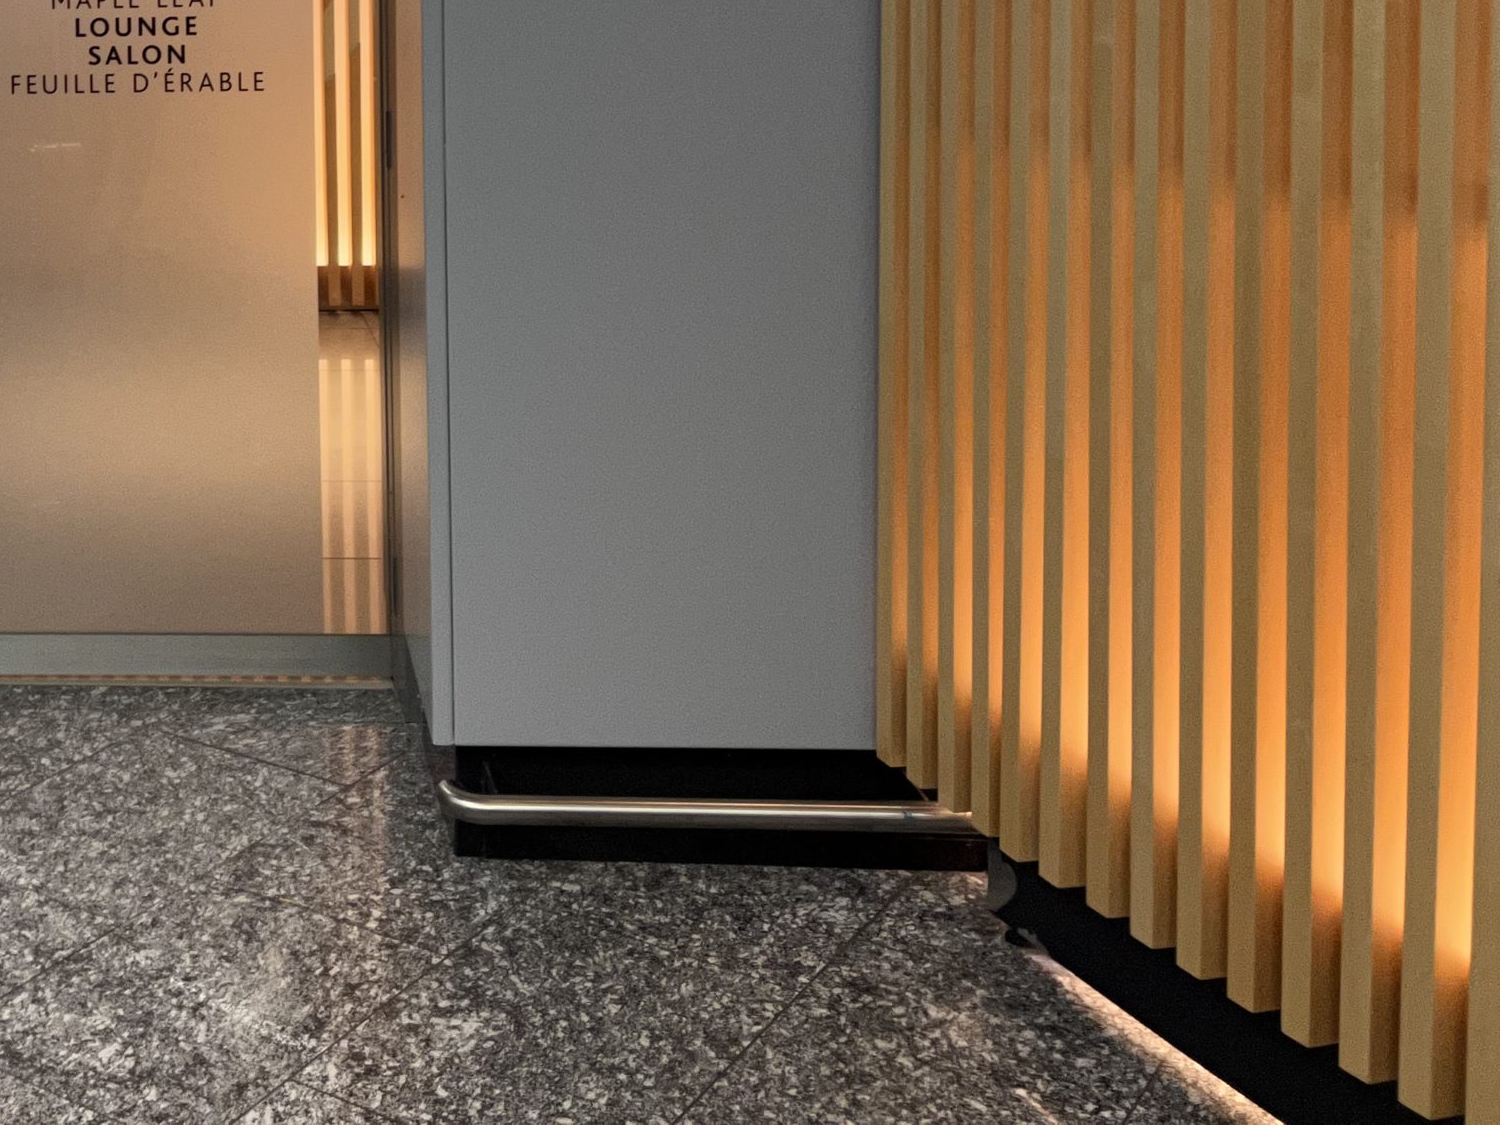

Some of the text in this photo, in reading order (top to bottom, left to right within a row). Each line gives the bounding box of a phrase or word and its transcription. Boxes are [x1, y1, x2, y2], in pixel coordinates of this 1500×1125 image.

[75, 16, 198, 38] LOUNGE
[88, 44, 186, 65] SALON
[10, 68, 266, 95] FEUILLE D'ÉRABLE
